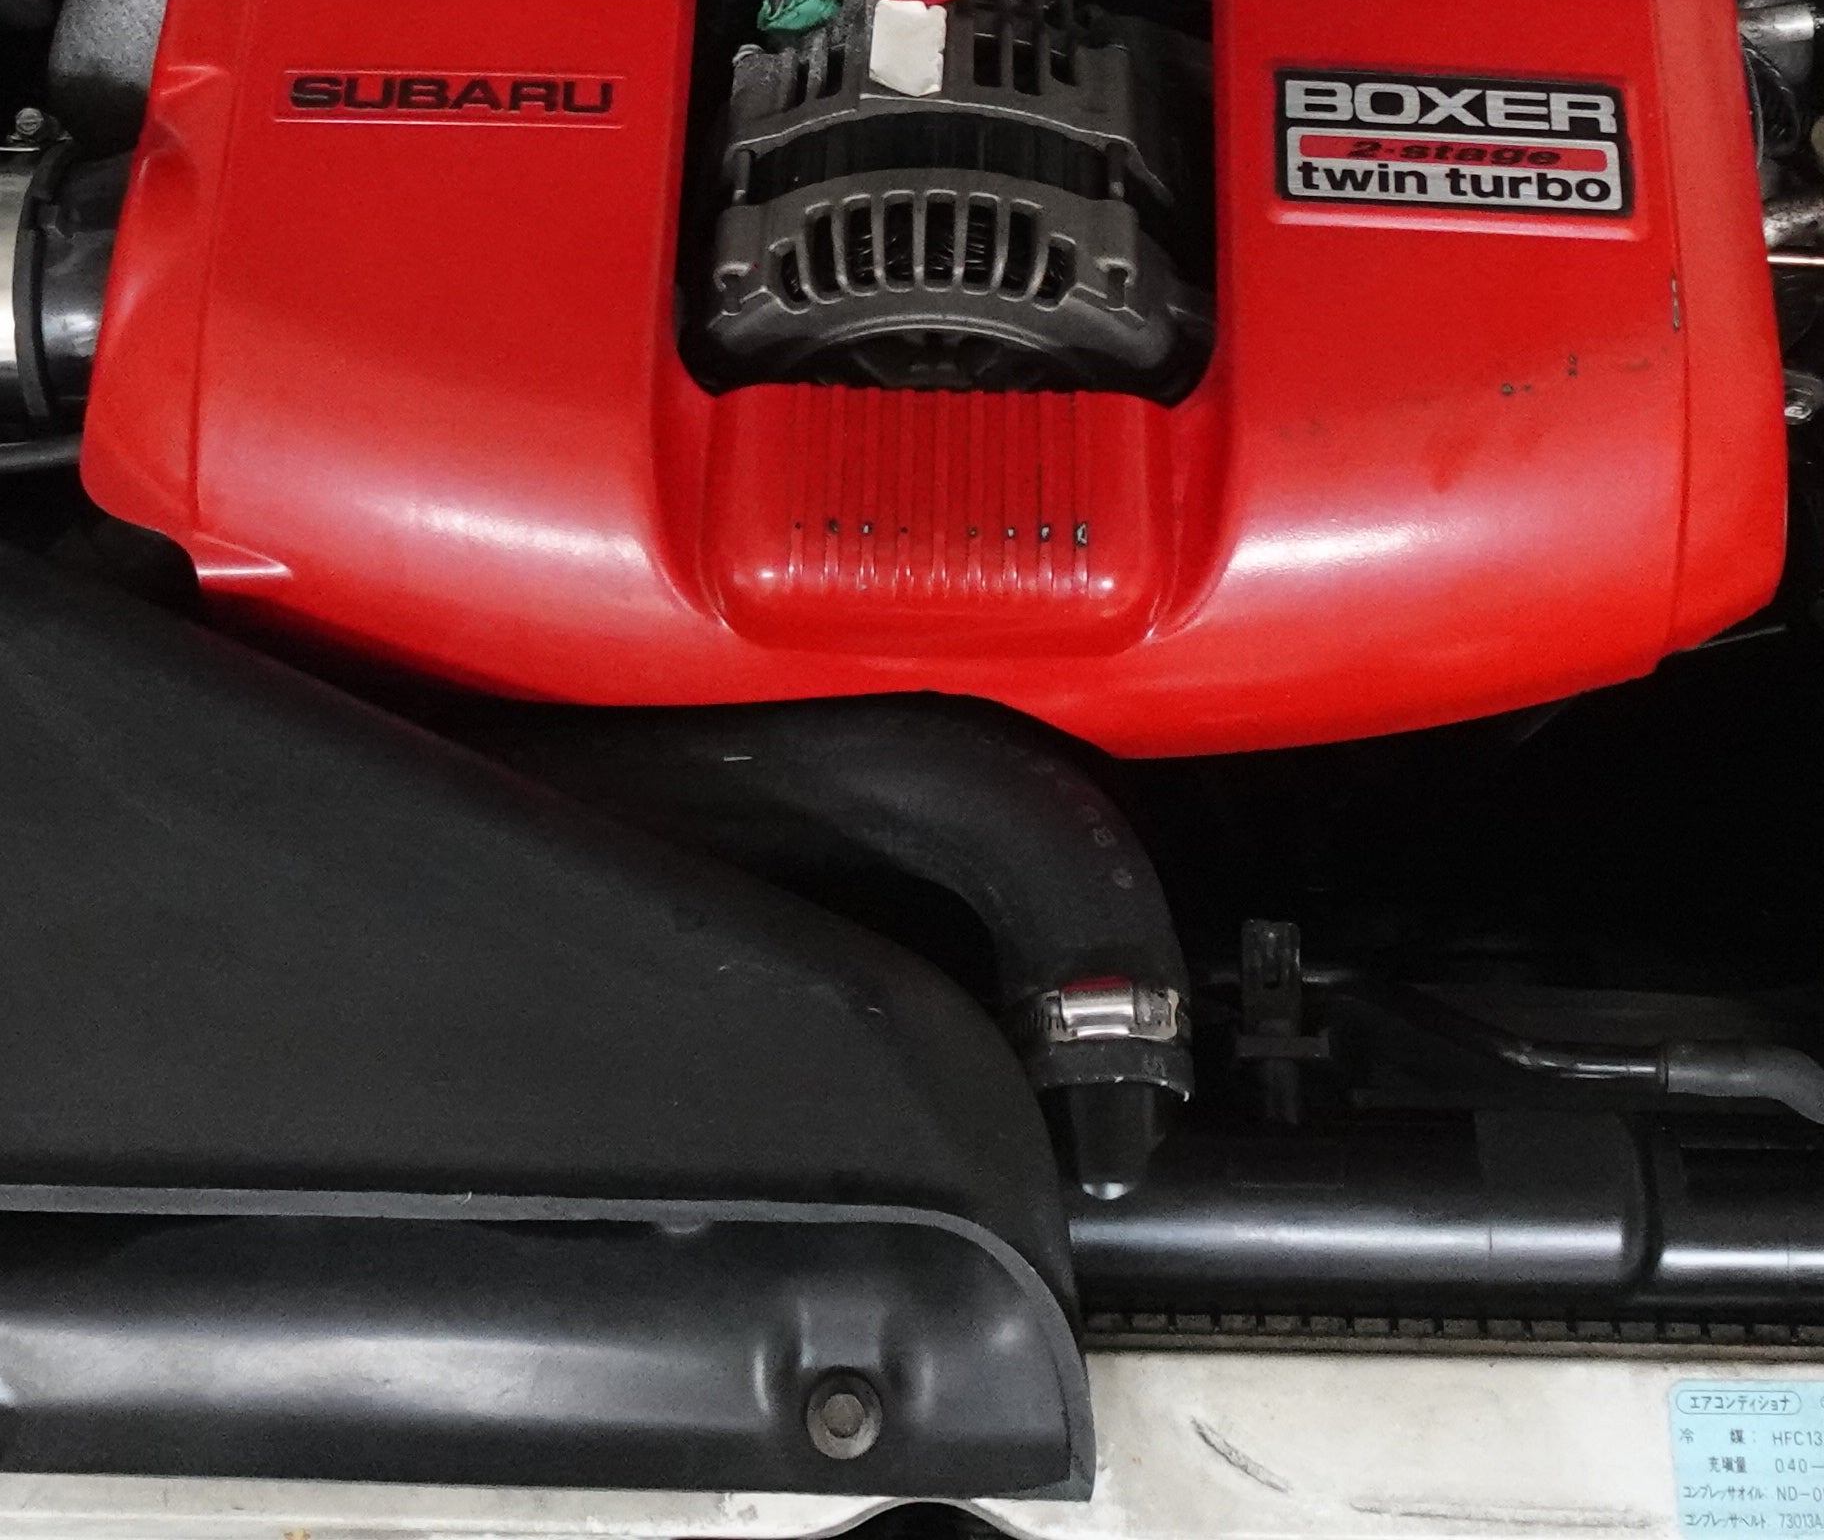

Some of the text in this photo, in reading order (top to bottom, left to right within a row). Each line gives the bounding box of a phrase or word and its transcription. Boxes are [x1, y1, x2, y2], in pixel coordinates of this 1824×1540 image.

[290, 76, 614, 113] SUBARU
[1284, 79, 1618, 134] BOXER
[1347, 140, 1562, 166] 2-stage
[1296, 161, 1612, 203] twin turbo
[1690, 1395, 1791, 1411] エアコンディショナ
